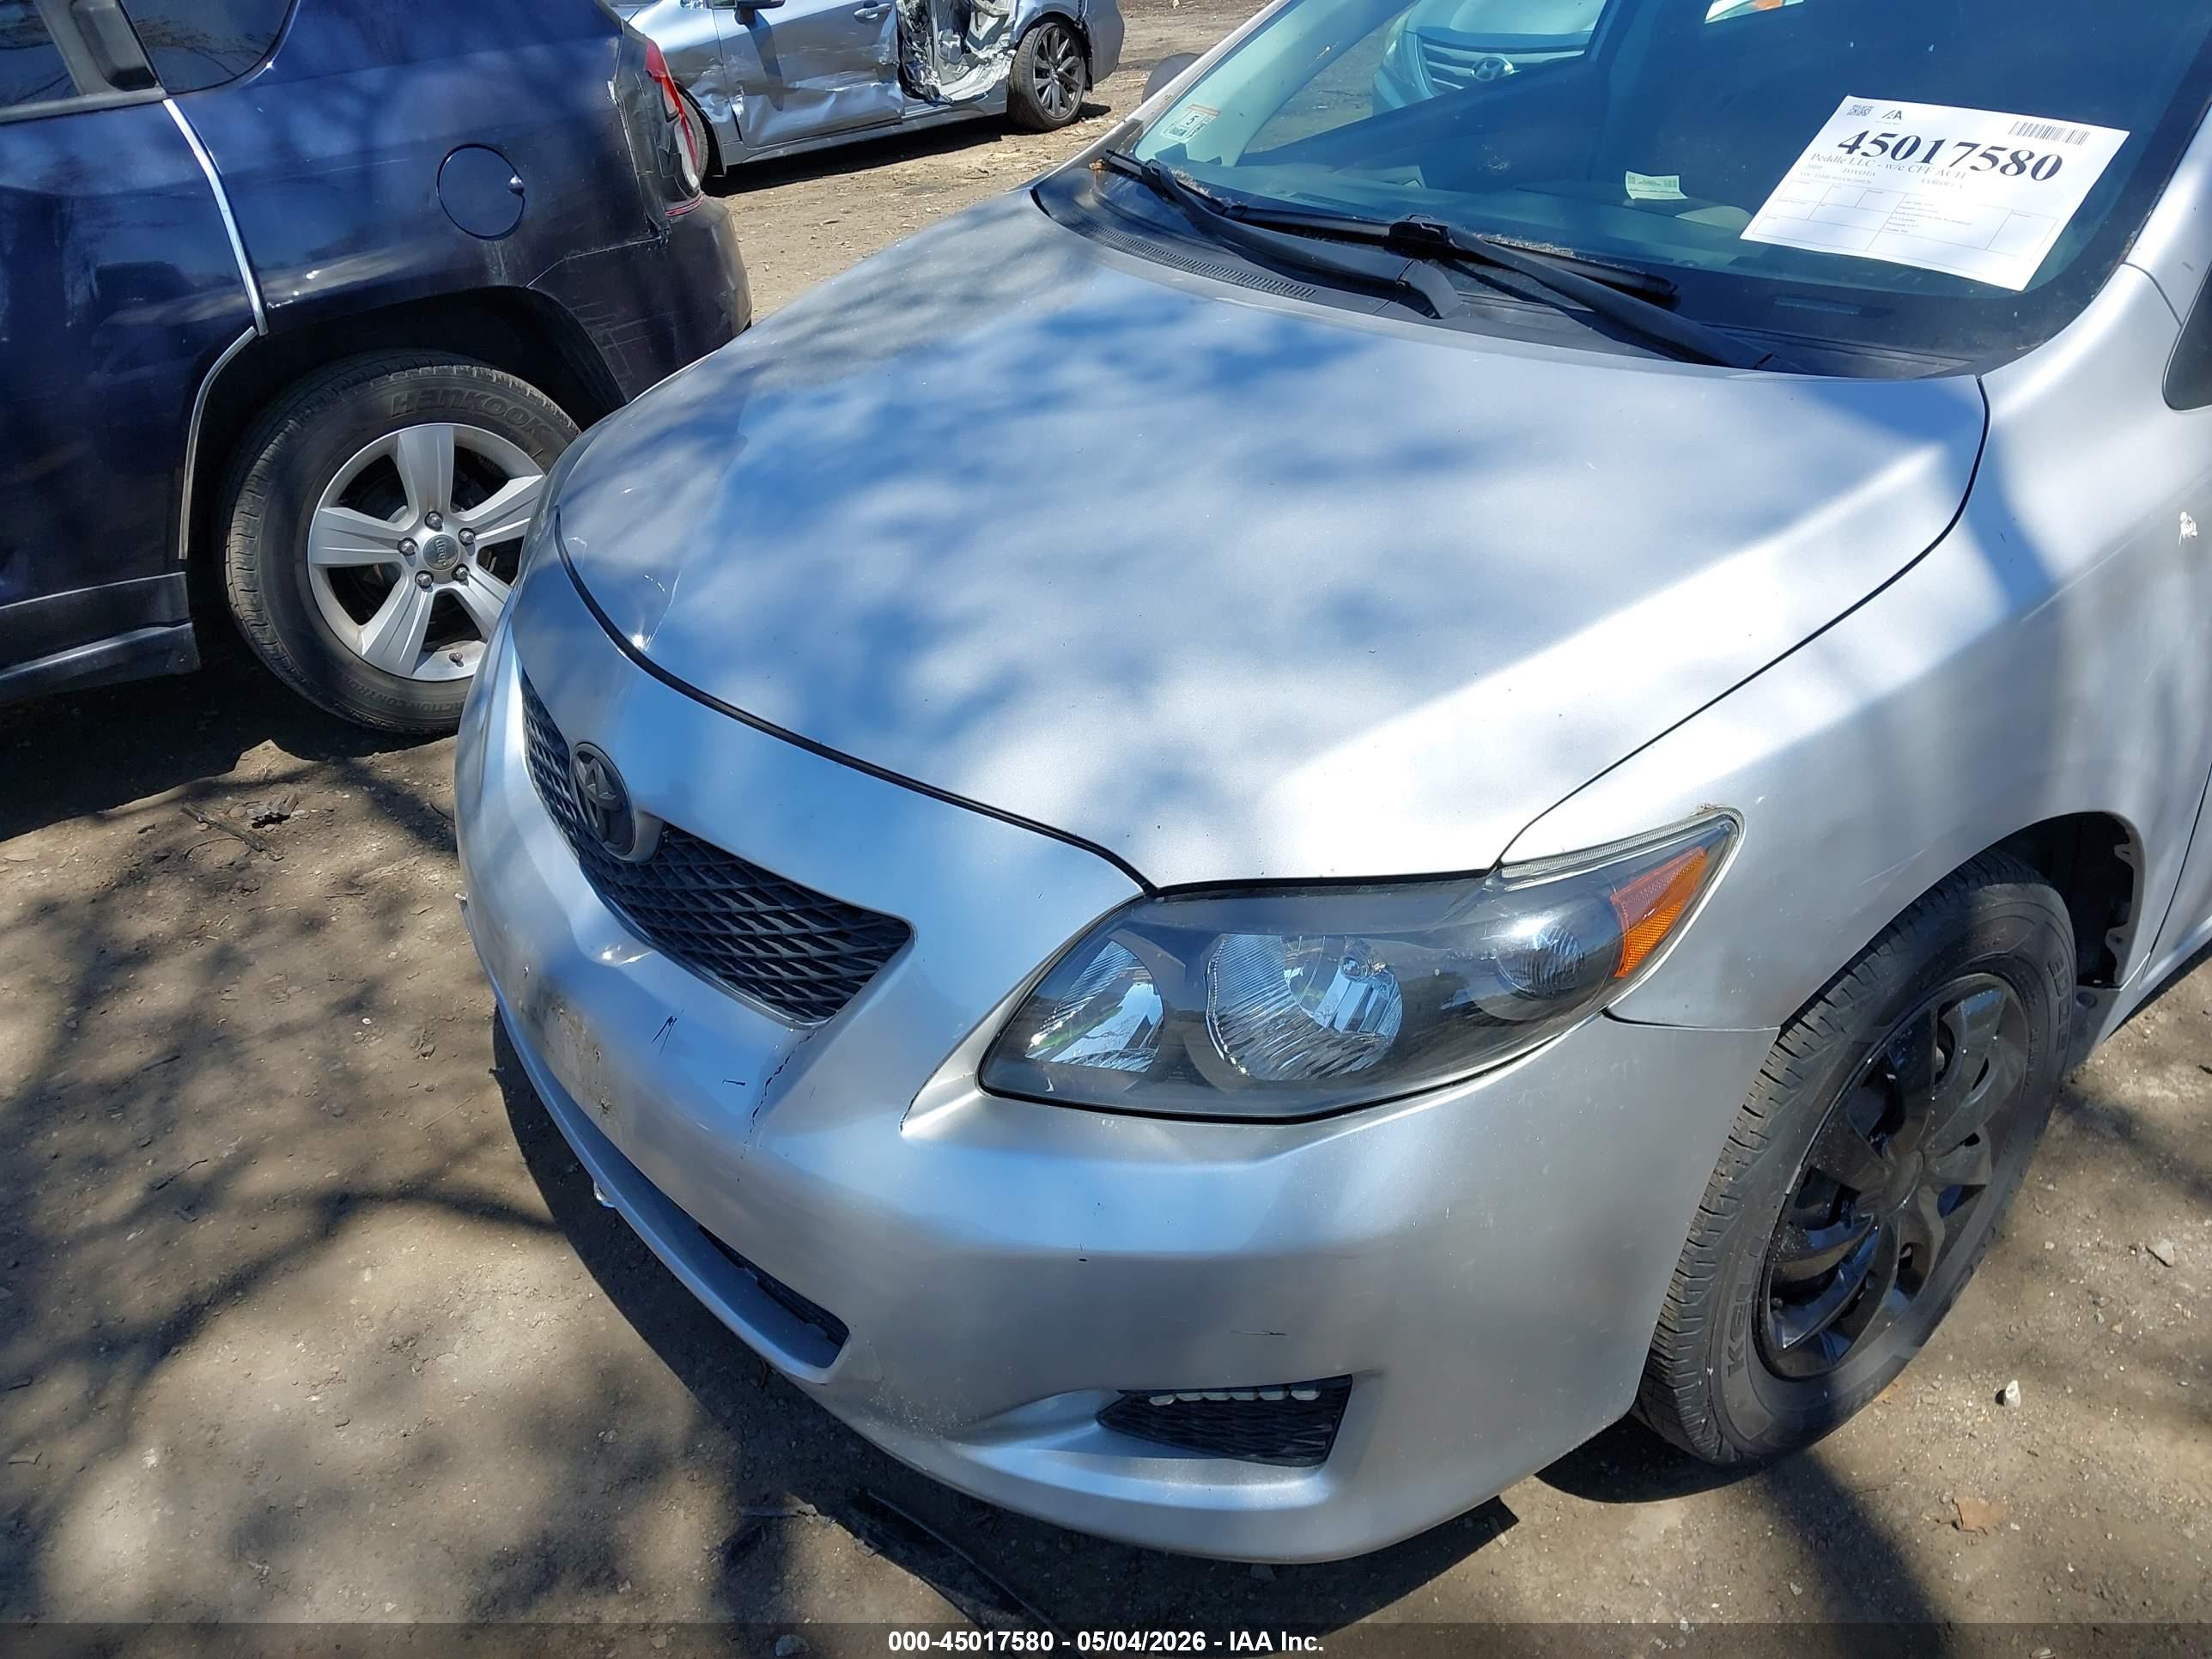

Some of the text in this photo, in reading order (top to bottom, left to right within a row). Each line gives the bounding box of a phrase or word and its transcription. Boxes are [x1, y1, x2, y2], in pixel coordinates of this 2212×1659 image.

[1810, 153, 1846, 164] Peddle
[1849, 158, 1876, 167] LLC
[1838, 130, 2063, 182] 45017580
